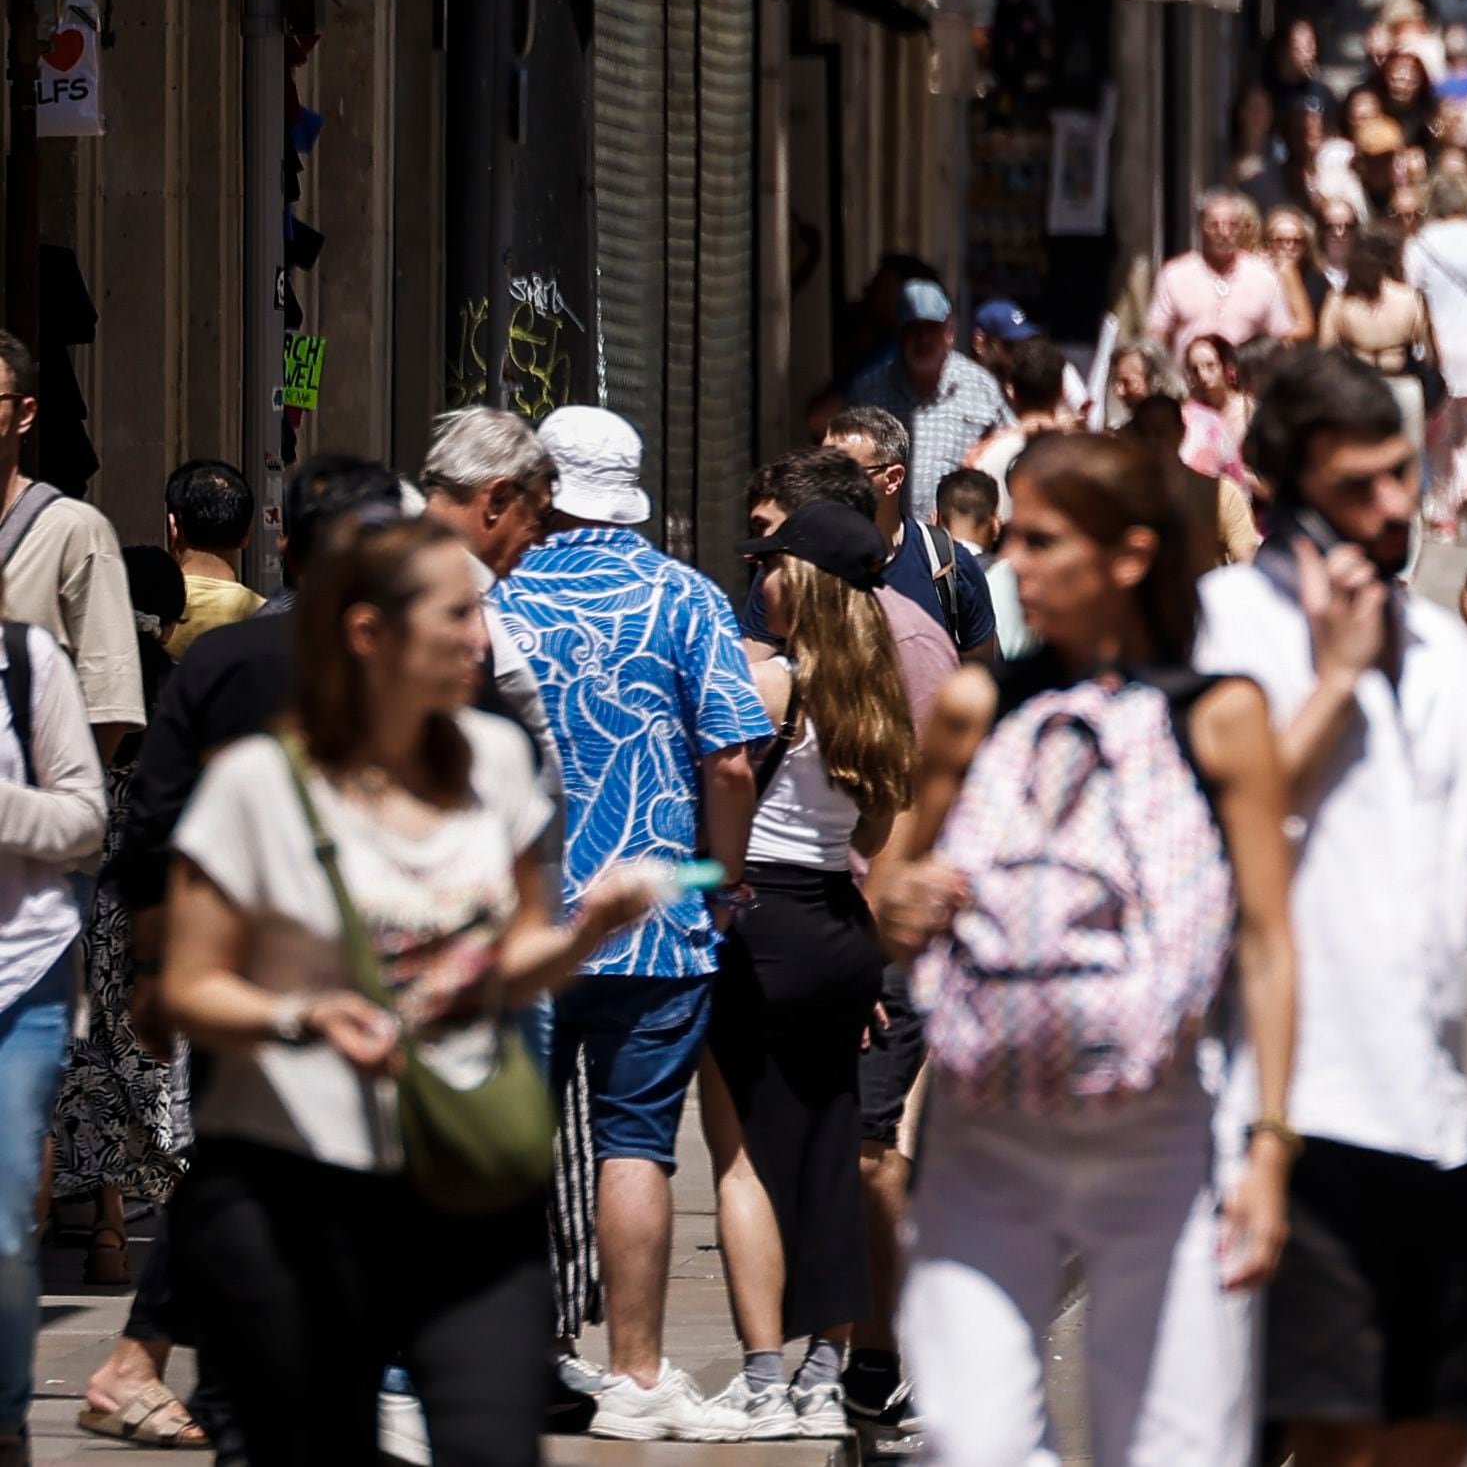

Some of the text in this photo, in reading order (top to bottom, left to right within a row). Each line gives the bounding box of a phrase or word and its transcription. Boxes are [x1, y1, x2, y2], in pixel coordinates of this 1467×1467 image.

[37, 78, 89, 105] LFS
[284, 336, 320, 365] ACH
[282, 357, 319, 390] WEL
